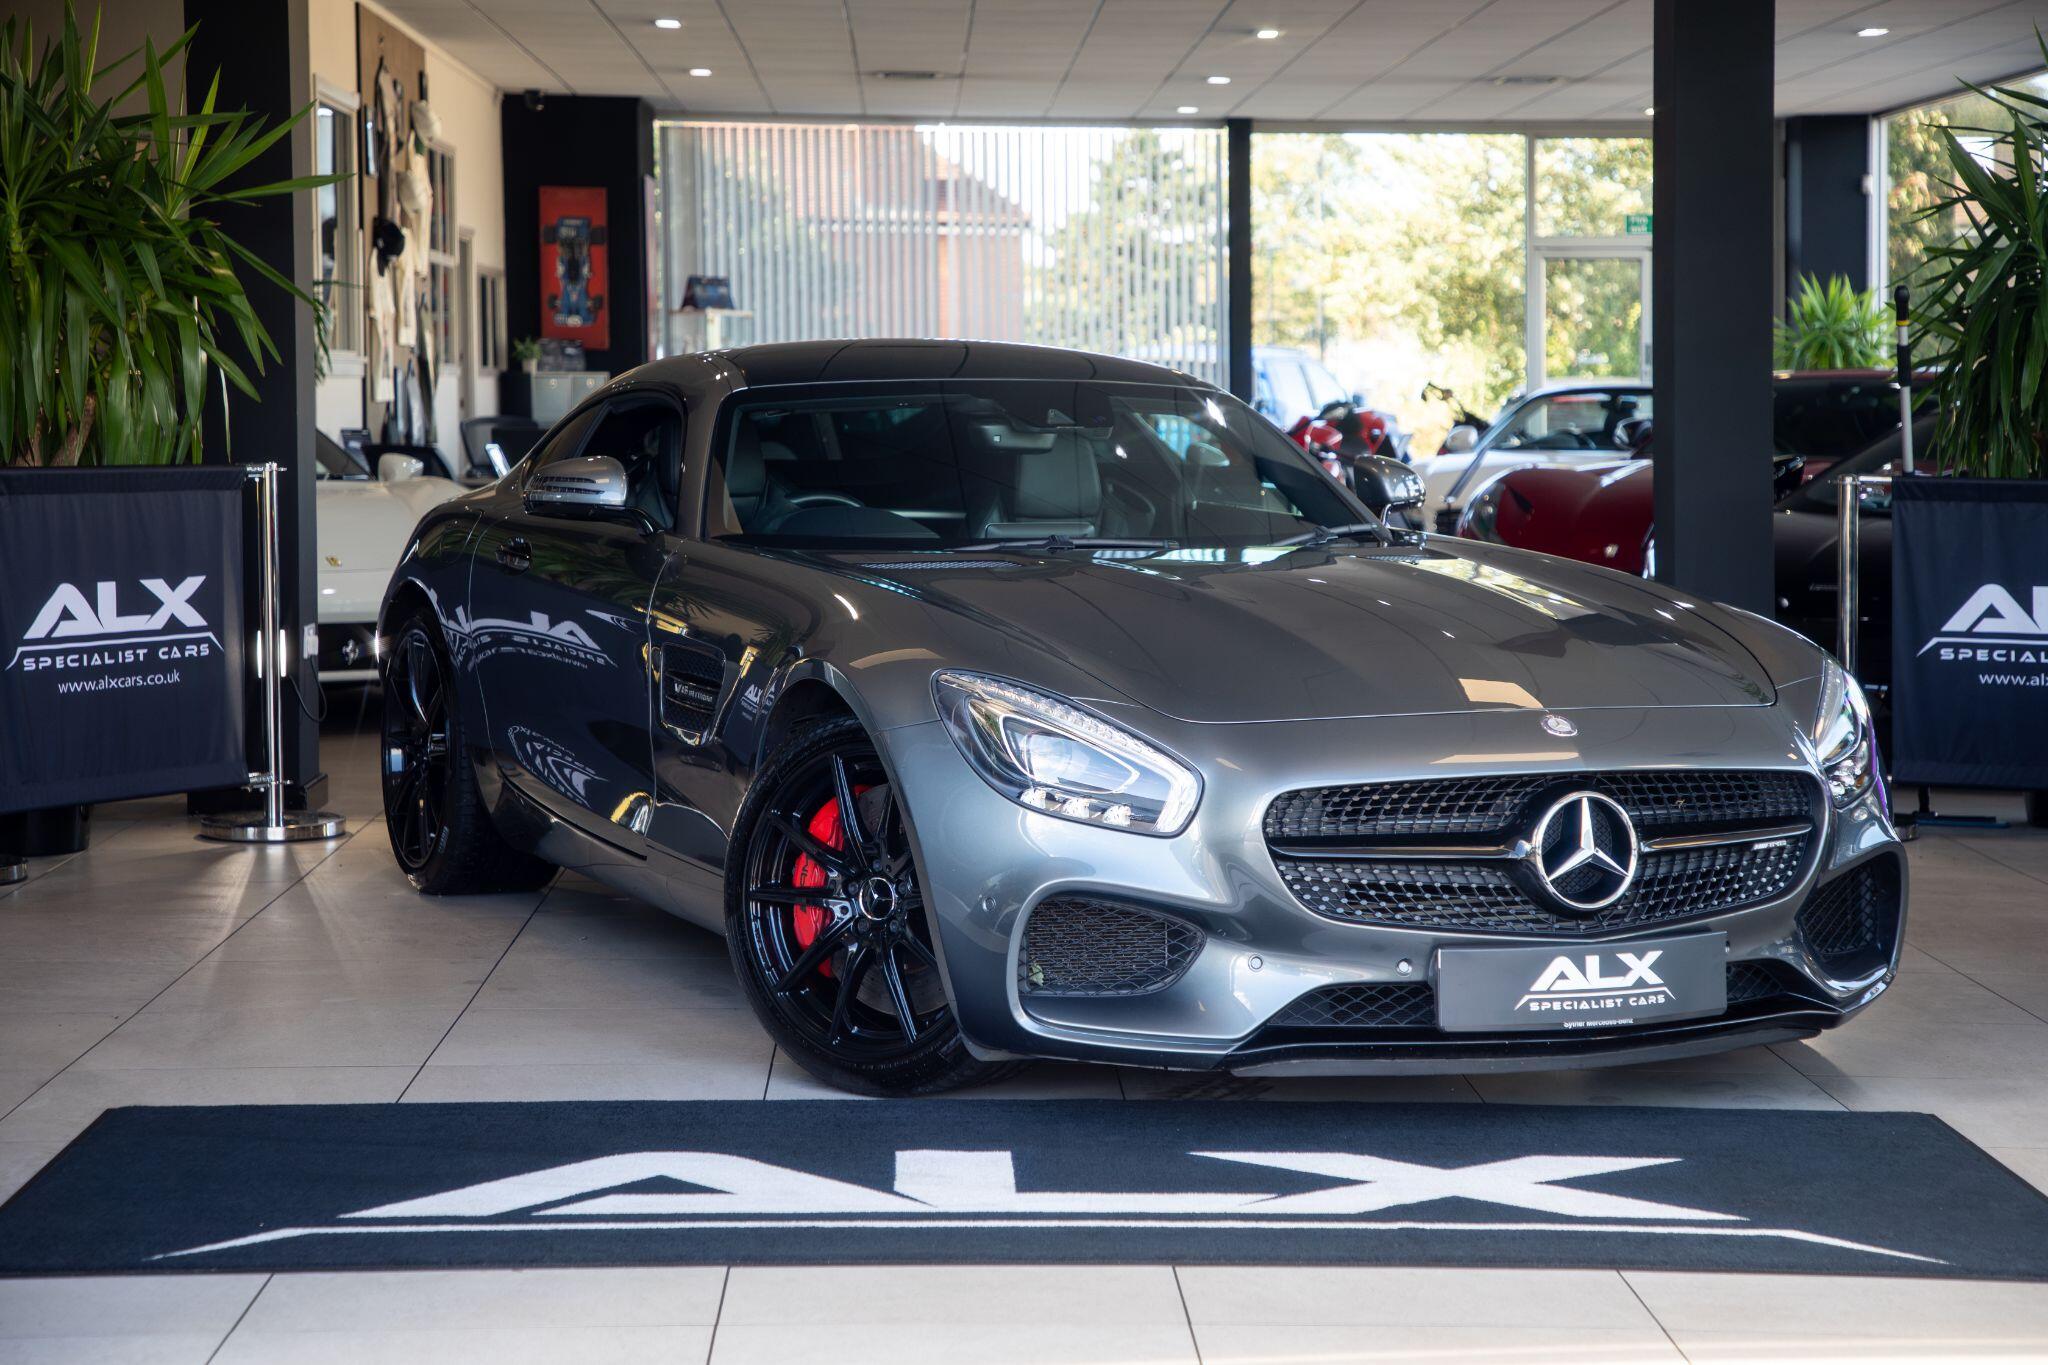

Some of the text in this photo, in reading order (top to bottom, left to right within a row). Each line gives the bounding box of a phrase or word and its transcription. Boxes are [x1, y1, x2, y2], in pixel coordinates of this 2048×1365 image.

[23, 575, 208, 640] ALX
[23, 643, 209, 671] SPECIALIST CARS
[58, 669, 181, 694] www.alxcars.co.uk
[1529, 950, 1665, 992] ALX
[1529, 995, 1666, 1012] SPECIALIST CARS
[335, 1150, 1750, 1221] ALX
